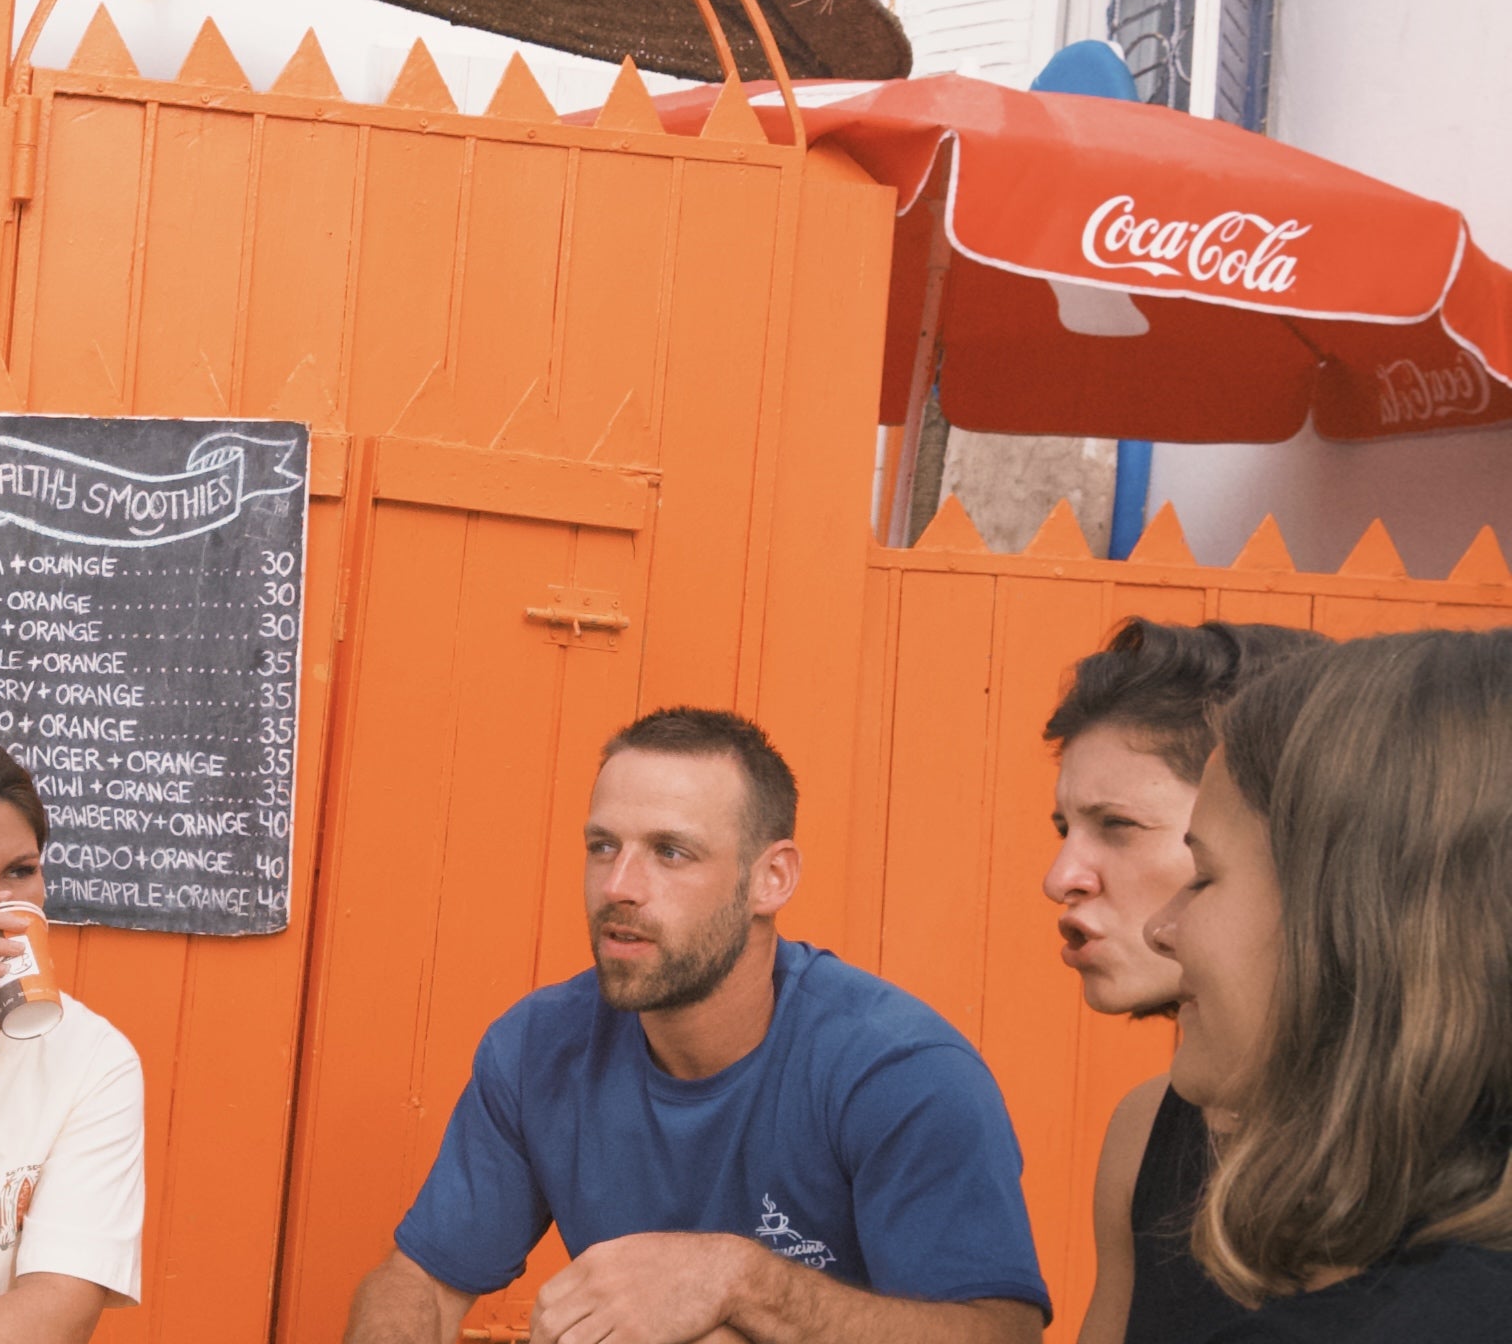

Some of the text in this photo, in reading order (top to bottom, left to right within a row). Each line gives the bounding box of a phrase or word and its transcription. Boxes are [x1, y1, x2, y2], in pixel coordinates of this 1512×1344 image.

[1082, 195, 1312, 292] Coca-Cola
[82, 474, 232, 521] SMOOTHIES
[28, 555, 119, 578] ORANGE
[261, 551, 294, 577] 30
[7, 590, 92, 615] ORANGE
[258, 582, 295, 606] 30
[18, 620, 103, 642] ORANGE
[259, 613, 295, 641] 30
[43, 651, 127, 674] ORANGE
[257, 650, 292, 676] 35
[55, 683, 145, 708] ORANGE
[260, 682, 293, 709] 35
[39, 714, 139, 742] ORANGE
[259, 717, 293, 744] 35
[127, 751, 228, 777] ORANGE
[258, 747, 292, 775] 35
[36, 774, 84, 798] KIWI
[106, 780, 193, 803] ORANGE
[256, 779, 290, 806] 35
[259, 809, 289, 838] 40
[256, 854, 285, 881] 40
